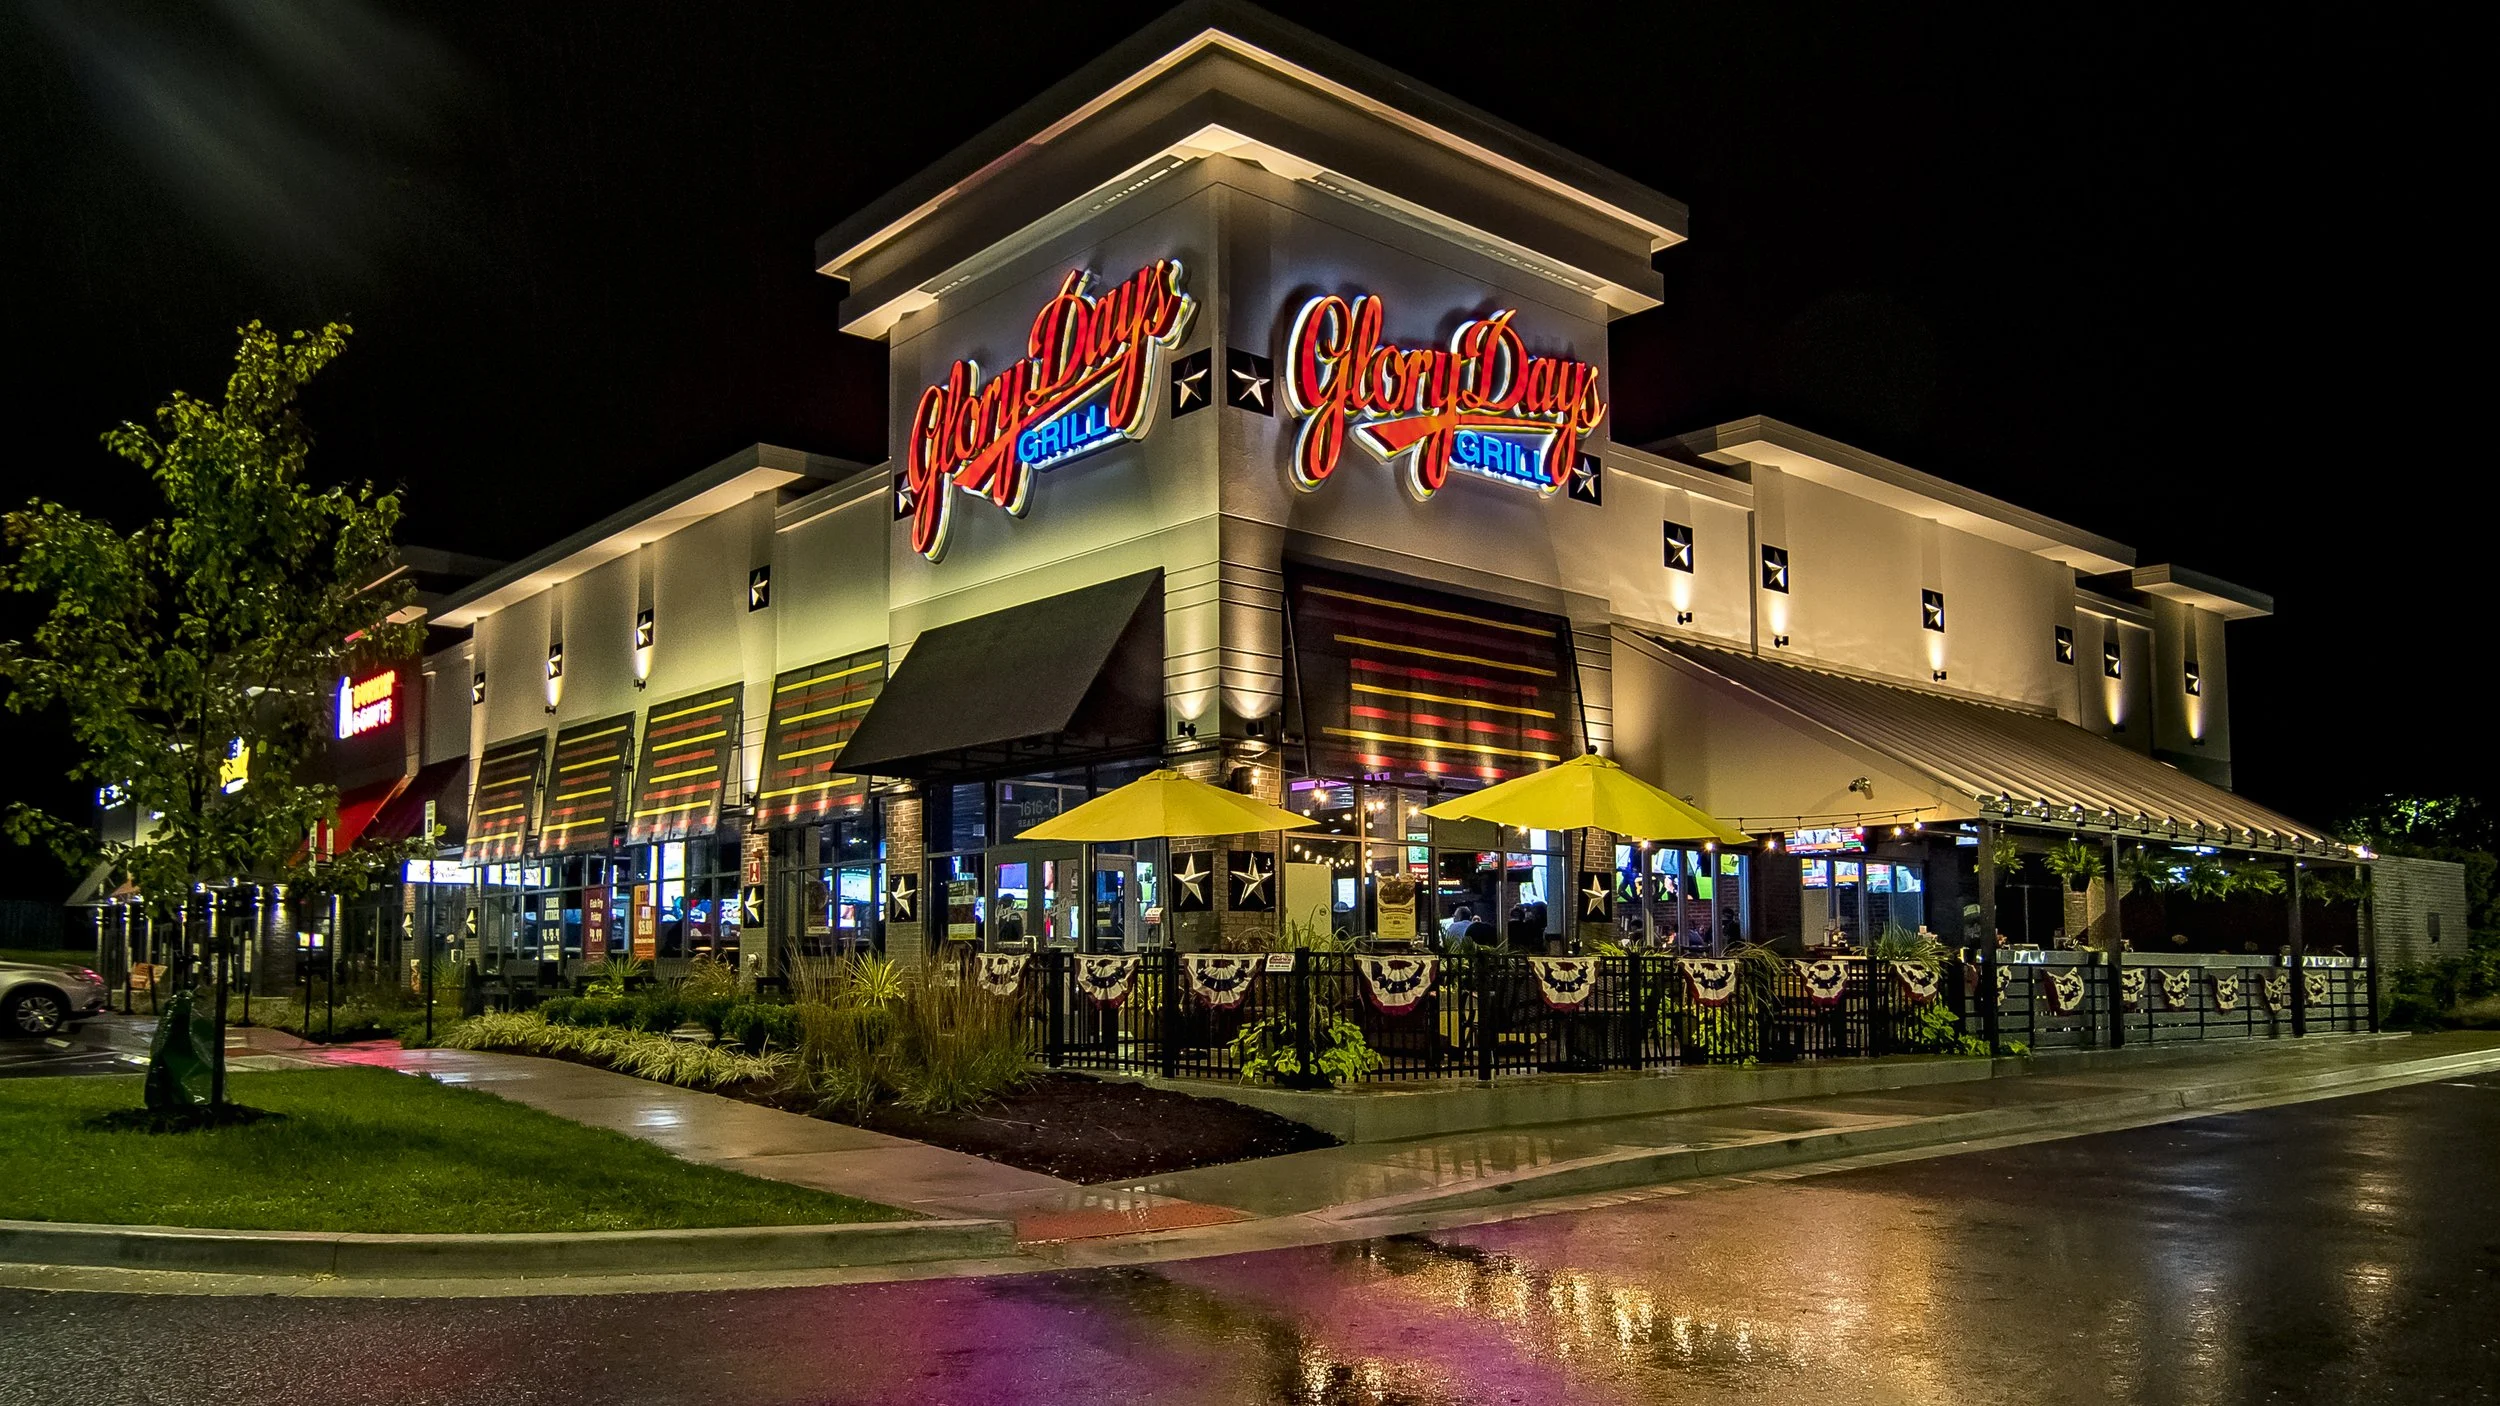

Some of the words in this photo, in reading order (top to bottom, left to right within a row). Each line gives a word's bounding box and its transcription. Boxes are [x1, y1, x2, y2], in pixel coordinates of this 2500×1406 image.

[908, 359, 1032, 554] Glory
[1025, 258, 1180, 429] Days
[1296, 294, 1463, 489] Glory
[1462, 308, 1606, 487] Days
[1018, 404, 1107, 463] GRILL
[1457, 429, 1552, 482] GRILL
[1020, 798, 1057, 817] 1616-C
